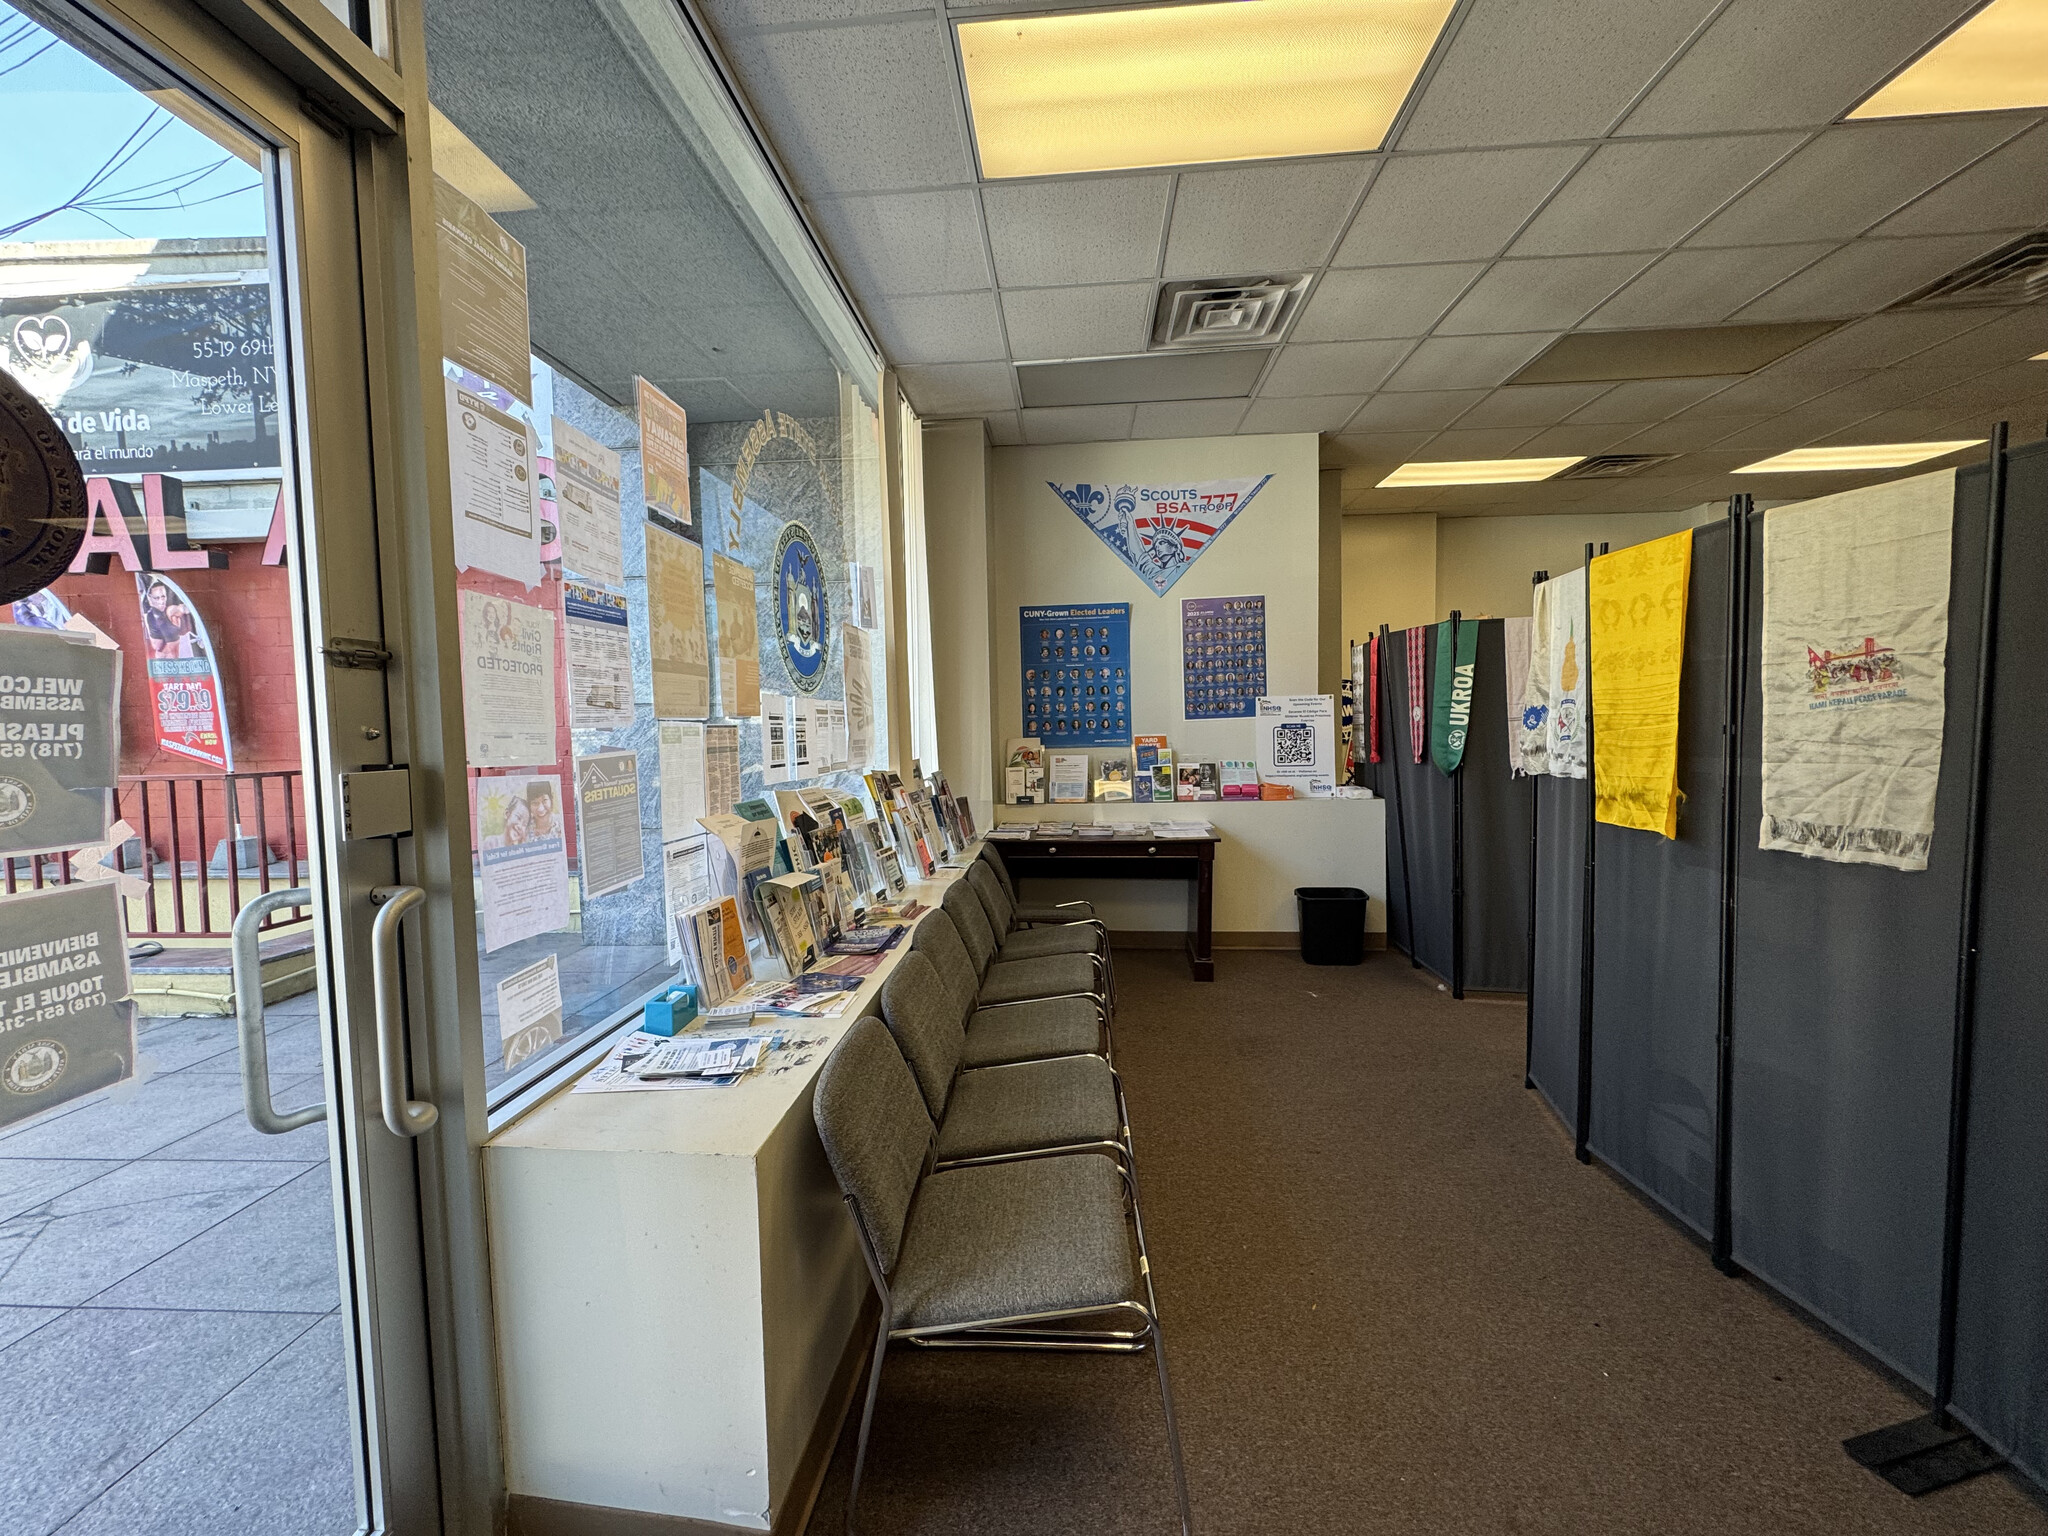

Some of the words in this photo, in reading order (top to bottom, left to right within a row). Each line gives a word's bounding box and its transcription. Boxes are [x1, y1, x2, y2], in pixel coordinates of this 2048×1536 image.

[193, 341, 234, 358] 55-19
[172, 366, 247, 392] Maspeth,
[200, 398, 253, 416] Lower
[68, 411, 96, 434] de
[99, 408, 151, 432] Vida
[95, 446, 107, 460] el
[109, 445, 154, 459] mundo
[1156, 502, 1192, 514] BSA
[1192, 502, 1234, 513] TROOP
[1200, 492, 1238, 514] 777
[1023, 610, 1069, 618] CUNY-Grown
[1070, 608, 1096, 616] Elected
[1449, 664, 1474, 725] UKROA
[1877, 688, 1908, 700] PARADE
